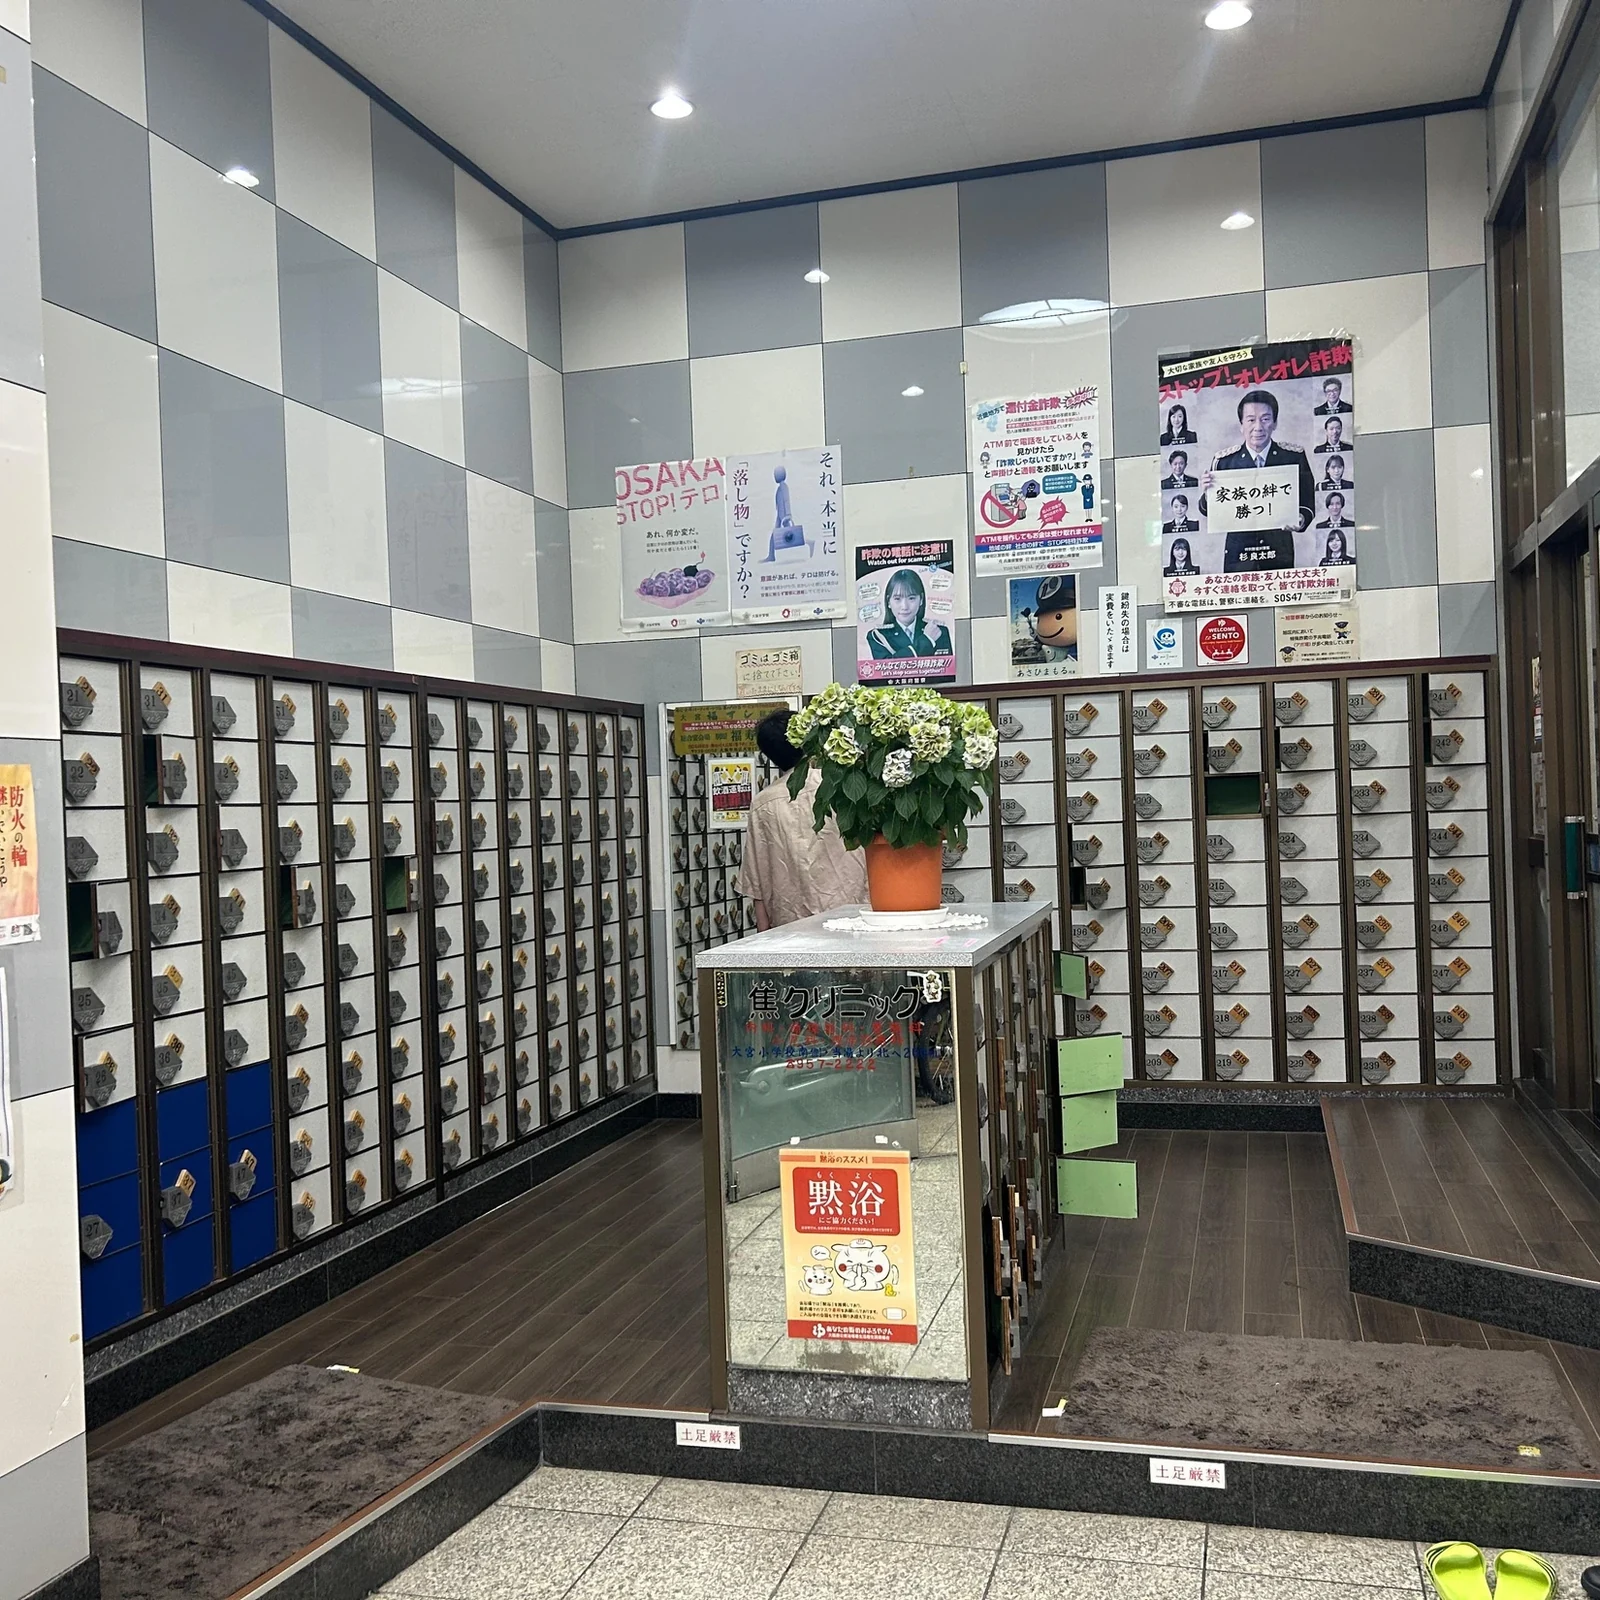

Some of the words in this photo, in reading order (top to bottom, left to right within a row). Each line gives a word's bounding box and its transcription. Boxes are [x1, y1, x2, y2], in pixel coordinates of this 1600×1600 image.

[1166, 351, 1248, 375] 大切な家族や友人を守ろう
[1158, 344, 1353, 404] ストップ!オレオレ詐欺
[977, 405, 1005, 420] 近畿地方で
[1005, 397, 1061, 414] 還付金詐欺
[983, 432, 1088, 449] ATM前で電話をしている人を
[1016, 445, 1055, 456] 見かけたら
[996, 453, 1078, 468] 「詐欺じゃないですか?」
[984, 461, 1089, 479] と声掛けと通報をお願いします
[615, 457, 726, 501] OSAKA
[1216, 483, 1293, 503] 家族の絆で
[819, 452, 837, 555] それ、本当に
[1235, 502, 1272, 519] 勝つ!
[646, 528, 699, 539] あれ、何か変だ。
[733, 460, 752, 599] 「落し物」ですか?
[980, 528, 1094, 544] ATMを操作してもお金は受け取れません
[861, 543, 948, 560] 詐欺の電話に注意!!
[867, 557, 886, 566] Watch
[888, 557, 898, 565] out
[899, 556, 907, 564] for
[924, 554, 941, 562] calls!!
[760, 570, 839, 582] 意識があれば、テロは防げる。
[1204, 568, 1328, 583] あなたの家族・友人は大丈夫?
[1193, 578, 1340, 596] 今すぐ連絡を取って、皆で詐欺対策!
[1168, 597, 1269, 608] 不審な電話は、警察に連絡を。
[1274, 592, 1303, 603] SOS47
[1120, 592, 1130, 653] 鍵紛失の場合は
[1208, 626, 1236, 634] WELCOME
[1211, 632, 1240, 641] SENTO
[1017, 666, 1068, 678] あさひまもる
[66, 689, 79, 702] 21
[144, 694, 157, 707] 31
[215, 700, 226, 712] 41
[275, 706, 285, 717] 51
[70, 766, 84, 778] 22
[279, 770, 290, 781] 52
[10, 785, 28, 867] 防火の輪
[78, 994, 91, 1008] 25
[748, 985, 922, 1020] 焦クリニック
[159, 1053, 170, 1065] 36
[819, 1155, 869, 1165] 黙浴のススメ!
[808, 1180, 885, 1217] 黙浴
[818, 1217, 875, 1226] にご協力ください!
[85, 1222, 100, 1237] 27
[681, 1428, 736, 1444] 土足厳禁
[1156, 1465, 1220, 1483] 土足厳禁
